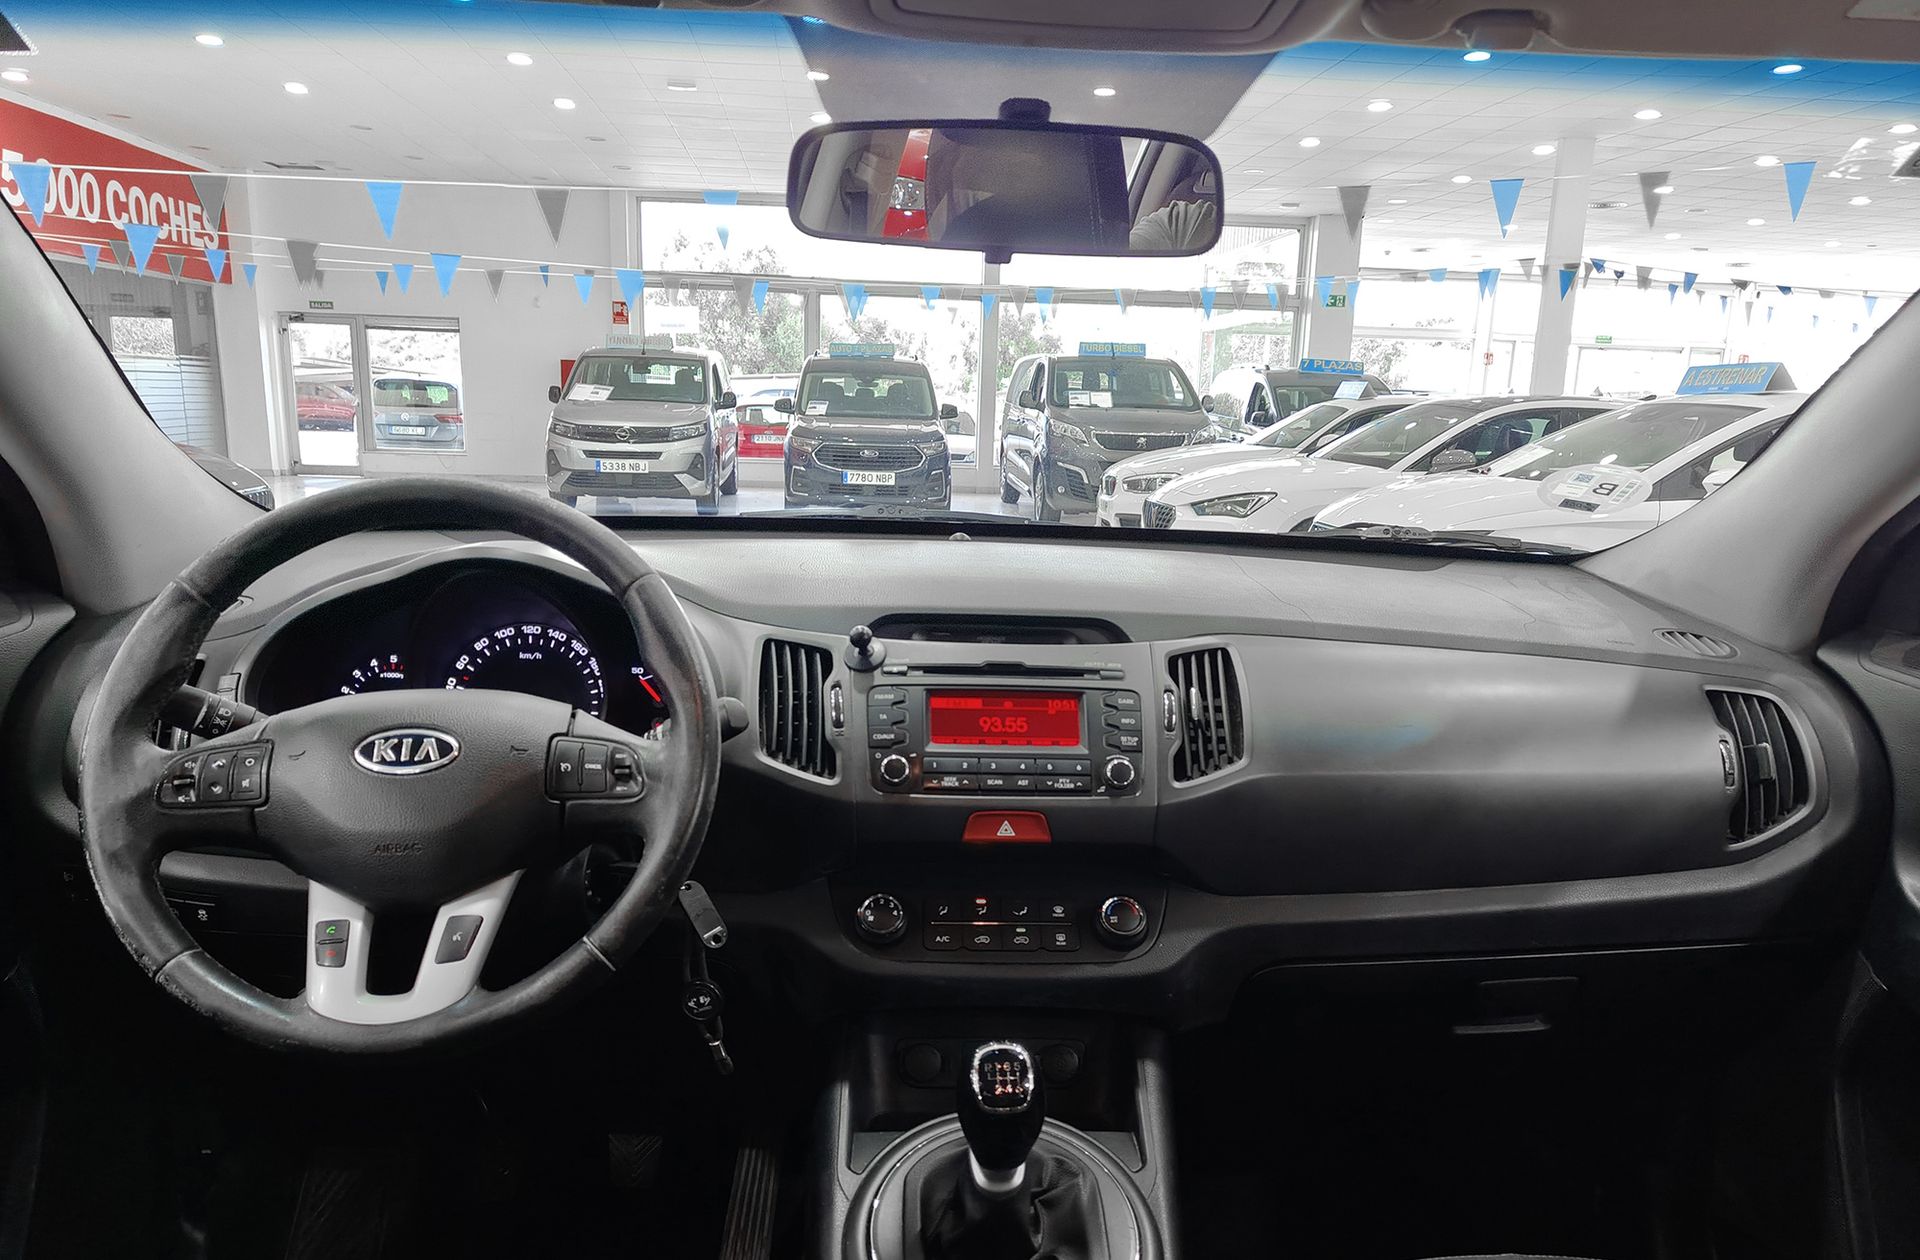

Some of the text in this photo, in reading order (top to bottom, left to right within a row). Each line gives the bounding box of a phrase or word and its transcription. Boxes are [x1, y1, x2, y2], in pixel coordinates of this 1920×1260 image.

[1, 148, 219, 249] 5000 COCHES
[1081, 344, 1144, 353] TURBO DIESEL
[1303, 359, 1363, 371] 7 PLAZAS
[1682, 367, 1768, 386] A ESTRENAR
[602, 462, 647, 471] 5338 NBJ
[849, 473, 892, 483] 7780 NBP
[494, 627, 515, 639] 100
[521, 625, 542, 635] 120
[547, 628, 567, 642] 140
[474, 637, 489, 651] 80
[570, 639, 589, 656] 160
[390, 655, 398, 663] 5
[519, 651, 542, 661] km/h
[370, 658, 378, 667] 4
[456, 654, 469, 670] 60
[353, 670, 361, 678] 3
[341, 686, 350, 694] 2
[979, 716, 1028, 733] 93.55
[372, 738, 441, 762] KIA
[373, 841, 424, 854] AIRBAG
[935, 935, 951, 943] A/C
[984, 1063, 993, 1072] R
[1014, 1062, 1021, 1071] 5
